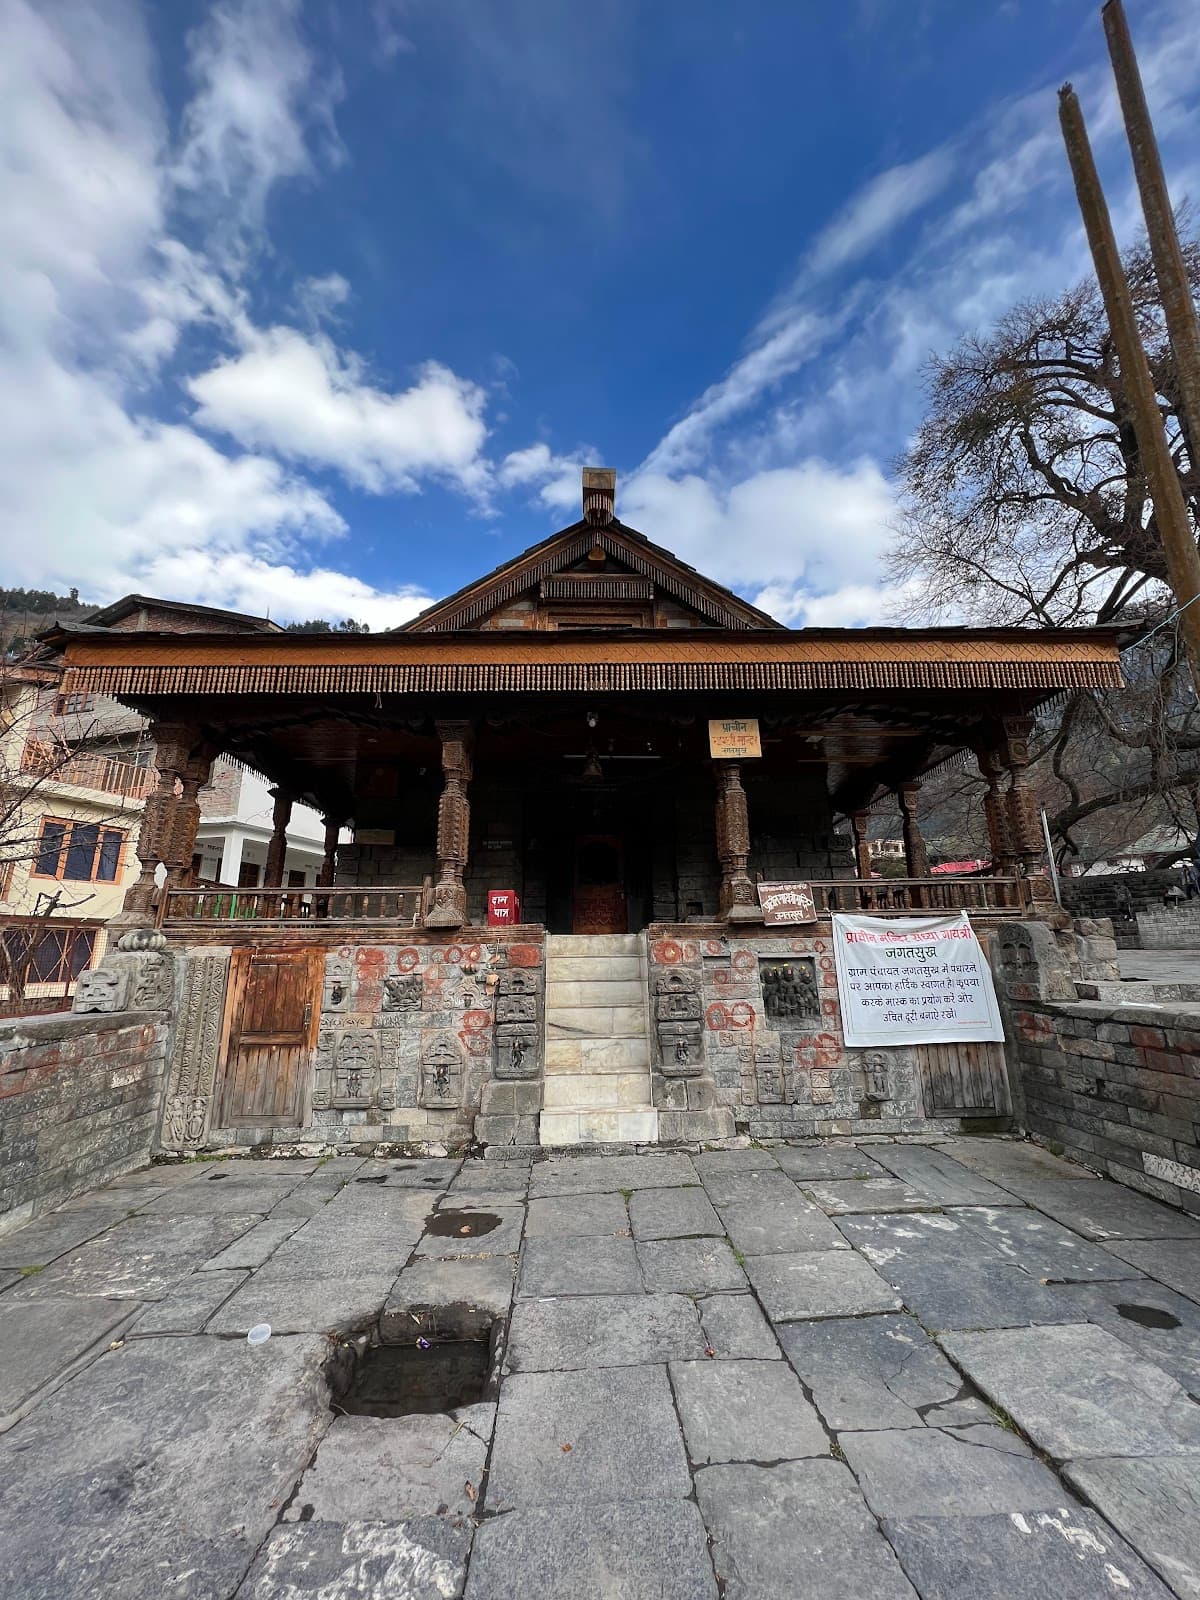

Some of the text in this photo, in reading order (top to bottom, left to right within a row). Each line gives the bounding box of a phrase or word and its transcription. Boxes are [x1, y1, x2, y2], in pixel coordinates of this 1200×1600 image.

[492, 896, 508, 905] दान
[846, 931, 876, 944] प्राचीन
[880, 930, 910, 944] मन्दिर
[942, 924, 972, 940] गायत्री
[885, 946, 937, 962] जगतसुख
[848, 968, 868, 977] ग्राम
[870, 966, 900, 977] पंचायत
[902, 966, 939, 978] जगतसुख
[950, 962, 977, 974] पधारने
[850, 982, 860, 991] पर
[864, 981, 892, 991] आपका
[920, 979, 945, 990] स्वागत
[956, 978, 980, 990] कृपया
[861, 996, 883, 1007] करके
[885, 997, 908, 1007] मास्क
[909, 997, 920, 1006] का
[922, 994, 942, 1006] प्रयोग
[883, 1011, 903, 1022] उचित
[905, 1010, 918, 1024] दूरी
